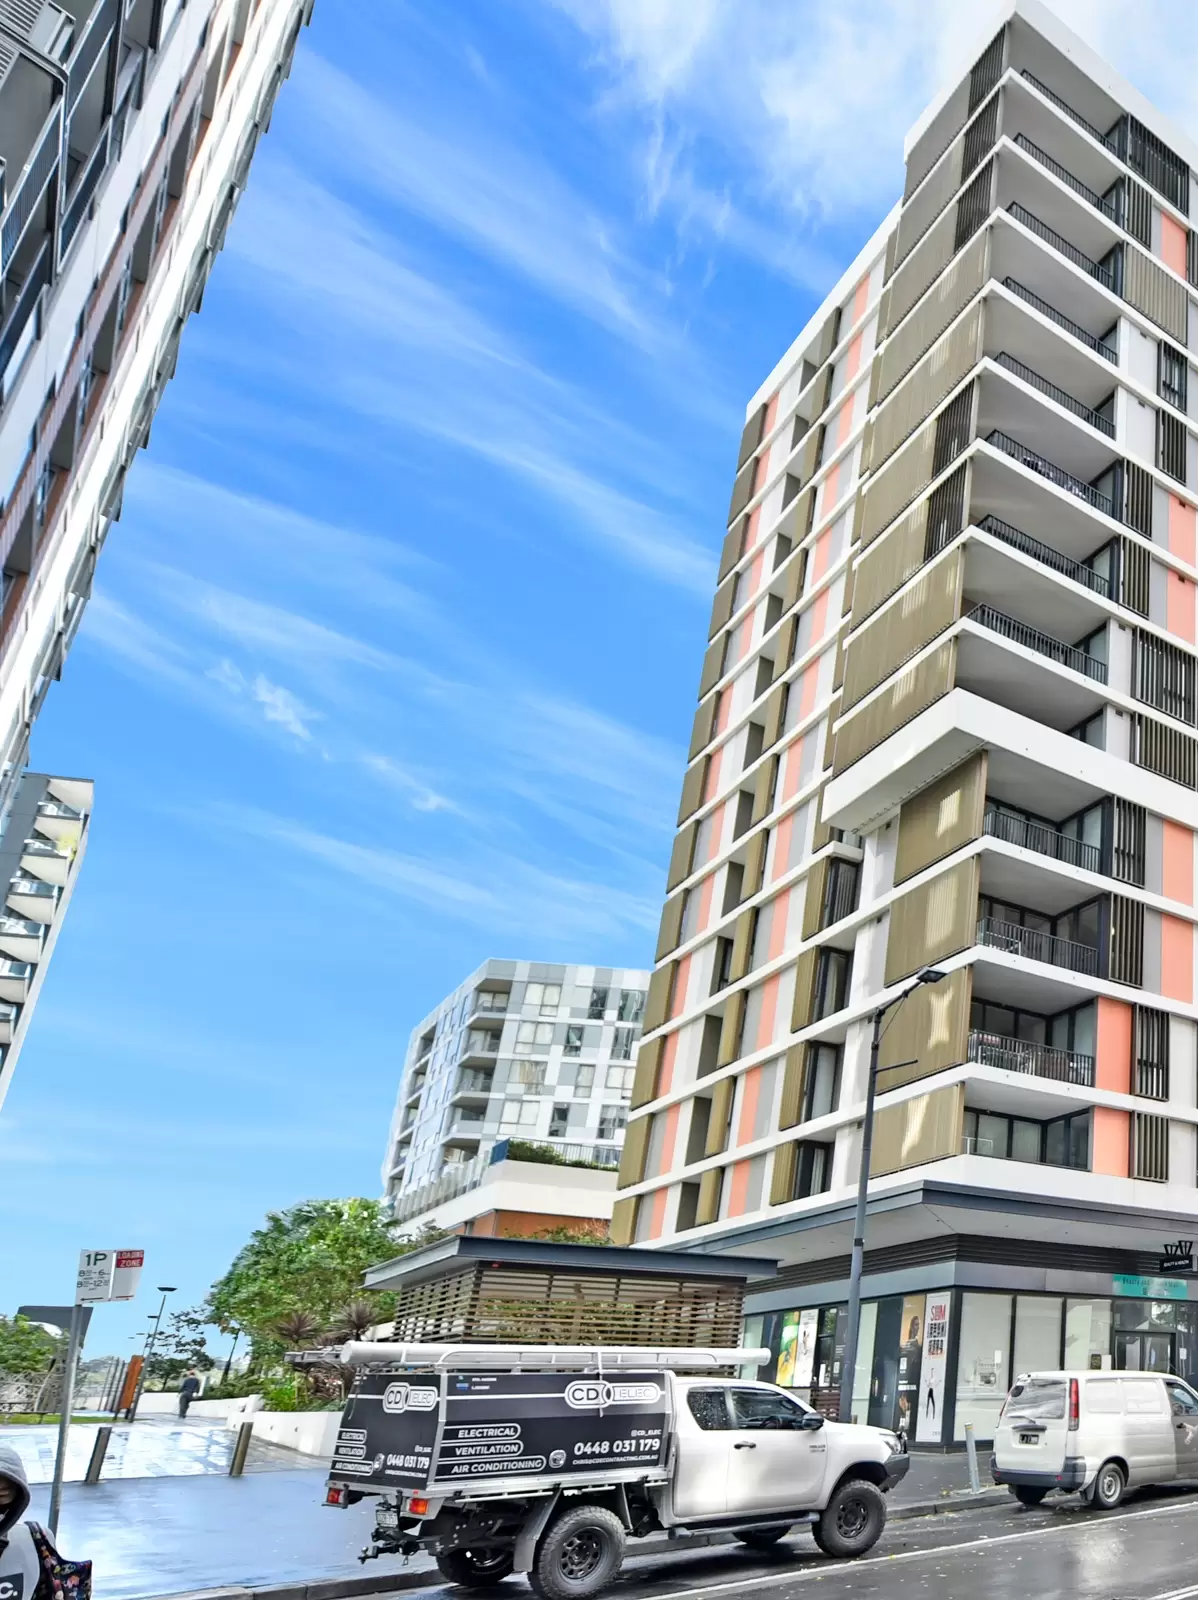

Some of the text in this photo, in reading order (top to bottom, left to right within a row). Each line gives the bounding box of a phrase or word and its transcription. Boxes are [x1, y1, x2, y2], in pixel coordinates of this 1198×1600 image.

[85, 1252, 107, 1266] 1P
[117, 1251, 144, 1259] LOADING
[120, 1258, 141, 1267] ZONE
[387, 1390, 433, 1405] CD ELEC
[572, 1387, 651, 1401] CD ELEC
[458, 1427, 516, 1438] ELECTRICAL
[630, 1429, 662, 1438] @CD_ELEC
[455, 1444, 519, 1456] VENTILATION
[574, 1438, 660, 1456] 0448 031 179
[386, 1454, 430, 1469] 0448 031 179
[451, 1460, 542, 1474] AIR CONDITIONING
